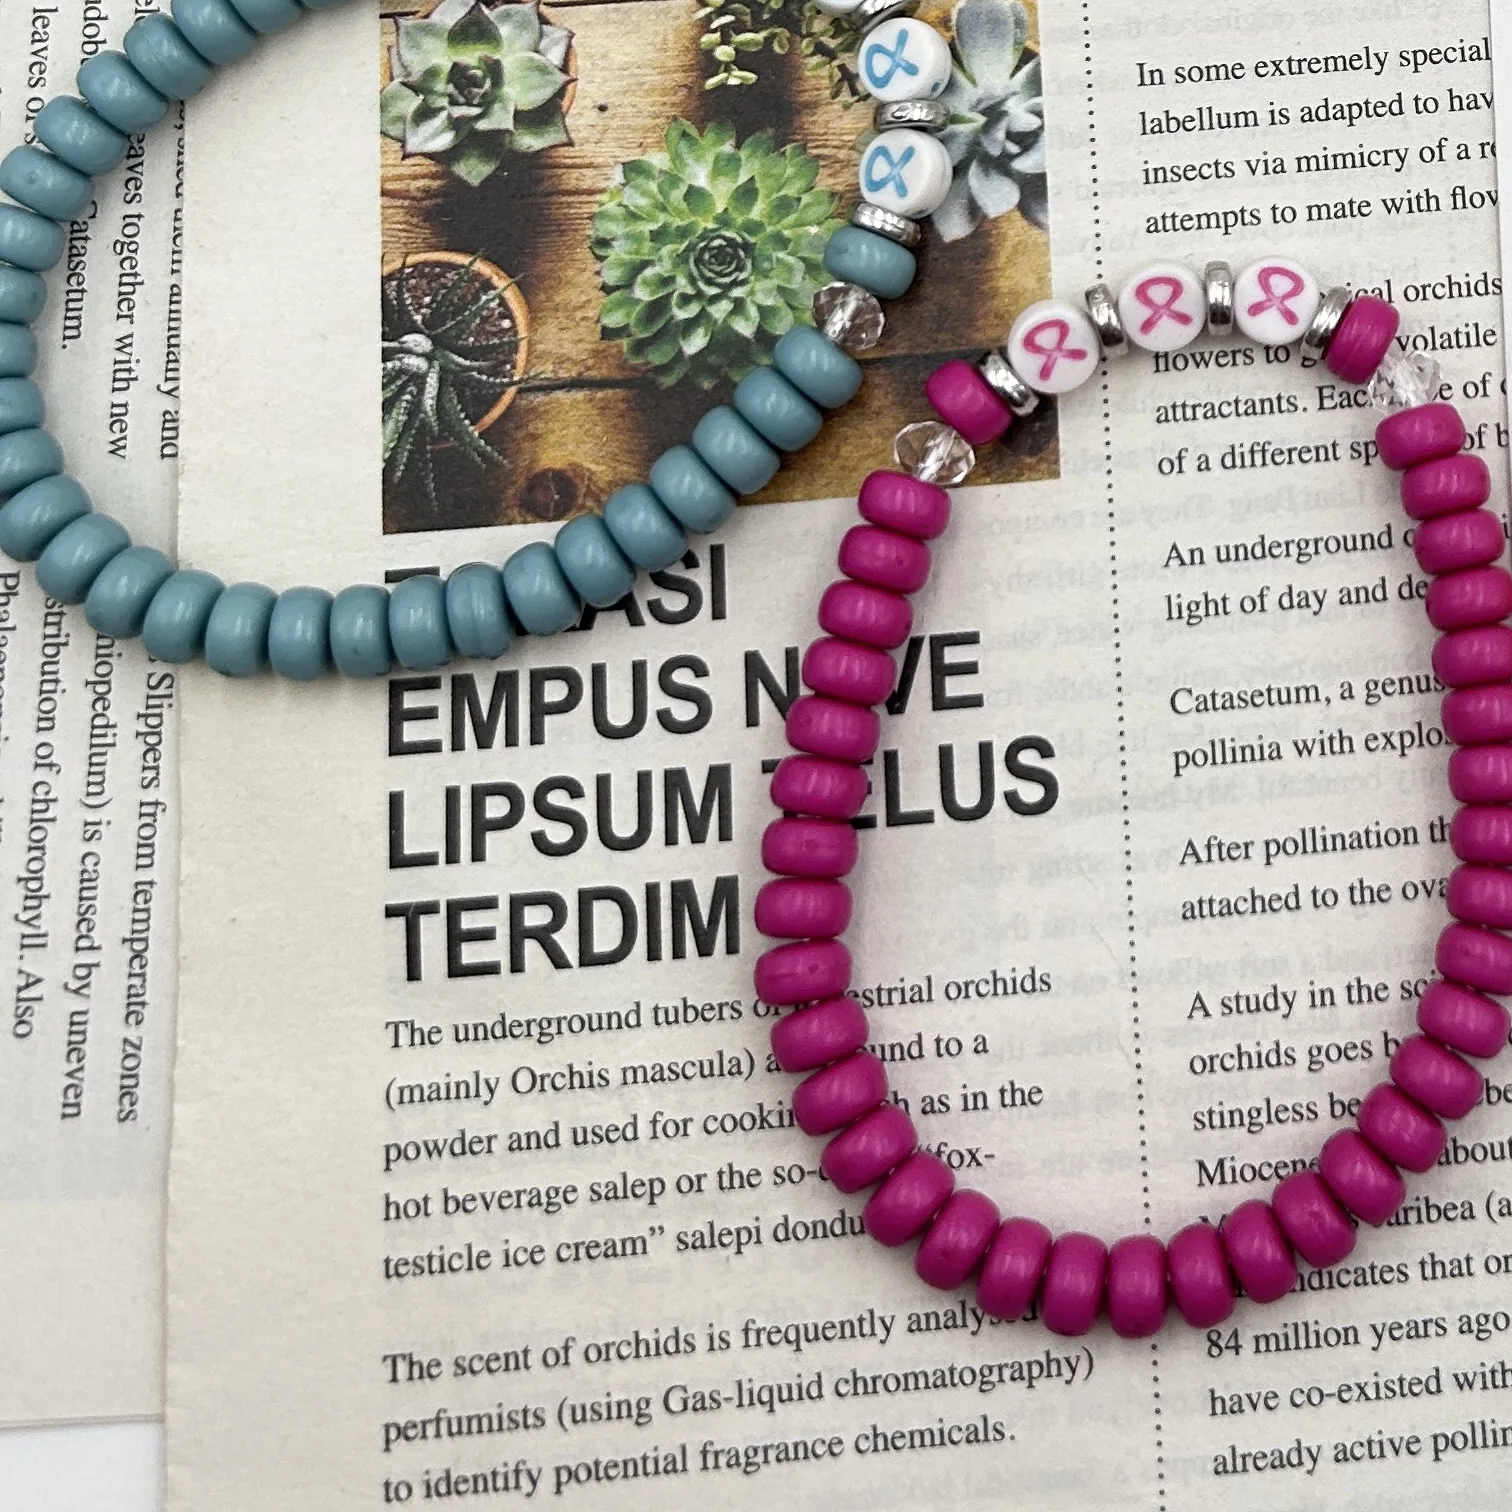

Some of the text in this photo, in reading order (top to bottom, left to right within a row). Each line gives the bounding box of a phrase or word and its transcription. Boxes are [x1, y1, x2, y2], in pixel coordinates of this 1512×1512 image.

[28, 6, 59, 88] leaves
[1136, 36, 1490, 87] In some extremely special
[1139, 92, 1405, 136] labellum adapted
[1142, 144, 1409, 185] insects via mimicry
[1146, 188, 1441, 235] attempts mate with
[1403, 271, 1502, 302] orchids
[108, 212, 145, 459] together with new
[1156, 392, 1307, 424] attractants.
[1220, 439, 1342, 470] different
[1163, 523, 1394, 568] An underground
[1165, 576, 1388, 627] light of day and
[389, 630, 985, 757] EMPUS NVE
[1170, 684, 1331, 715] Catasetum,
[1173, 727, 1355, 777] pollinia with
[389, 763, 734, 870] LIPSUM
[1179, 821, 1419, 867] After pollination
[13, 781, 59, 1039] chlorophyll. Also
[117, 672, 175, 1123] Slippers from temperate zones
[1182, 883, 1302, 922] attached
[385, 875, 740, 982] TERDIM
[61, 851, 102, 1120] caused by uneven
[385, 965, 1051, 1049] The underground tubers orchids
[1221, 983, 1297, 1020] study
[386, 1048, 755, 1112] (mainly Orchis mascula)
[1190, 1040, 1373, 1076] orchids goes
[1193, 1096, 1318, 1135] stingless
[384, 1111, 694, 1173] powder and used for
[384, 1162, 762, 1222] hot beverage salep or the
[384, 1220, 763, 1280] testicle ice cream” salepi
[382, 1308, 895, 1384] The scent of orchids is frequently
[1207, 1312, 1510, 1359] 84 million years ago
[383, 1347, 1093, 1453] perfumists (using Gas-liquid chromatography)
[1209, 1388, 1280, 1417] have
[1290, 1366, 1443, 1409] co-existed
[423, 1414, 1015, 1499] identify potential fragrance chemicals.
[1214, 1438, 1322, 1477] already
[1334, 1430, 1422, 1464] active
